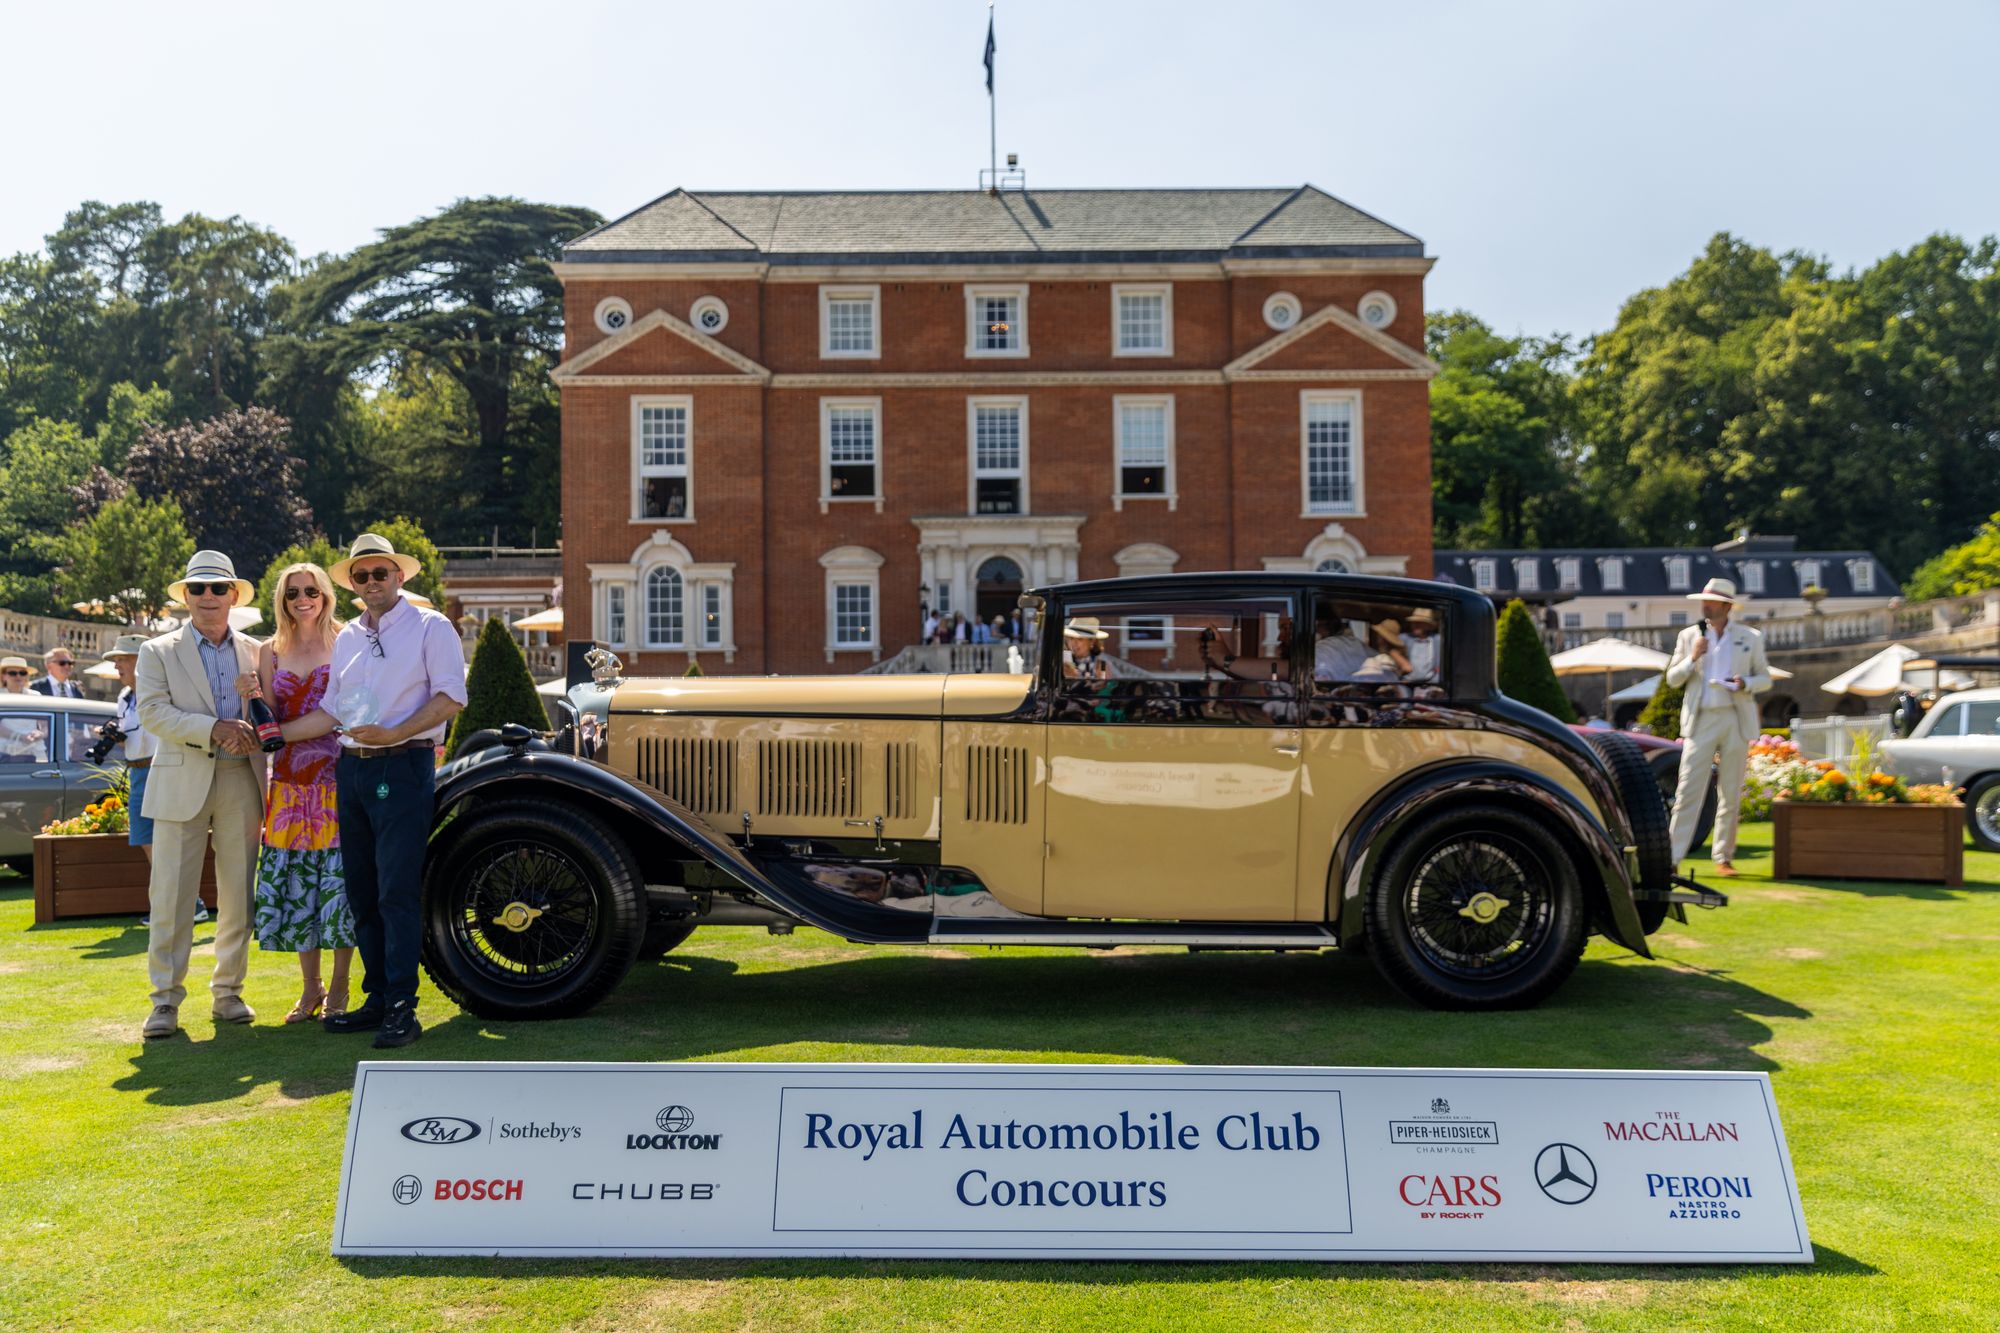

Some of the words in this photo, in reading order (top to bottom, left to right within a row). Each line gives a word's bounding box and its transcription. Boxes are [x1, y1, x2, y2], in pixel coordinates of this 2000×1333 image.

[1655, 1111, 1681, 1120] THE
[418, 1120, 461, 1142] RM
[499, 1121, 582, 1142] Sotheby's
[803, 1109, 924, 1161] Royal
[939, 1110, 1200, 1151] Automobile
[1216, 1111, 1320, 1152] Club
[1396, 1126, 1491, 1140] PIPER-HEIDSIECK
[1603, 1121, 1739, 1142] MACALLAN
[626, 1133, 720, 1150] LOCKTON
[1415, 1146, 1477, 1154] CHAMPAGNE
[434, 1179, 524, 1201] BOSCH
[572, 1183, 714, 1200] CHUBB
[956, 1169, 1167, 1208] Concours
[1399, 1174, 1502, 1207] CARS
[1645, 1173, 1753, 1198] PERONI
[1669, 1209, 1741, 1219] AZZURRO
[1678, 1201, 1727, 1209] NASTRO
